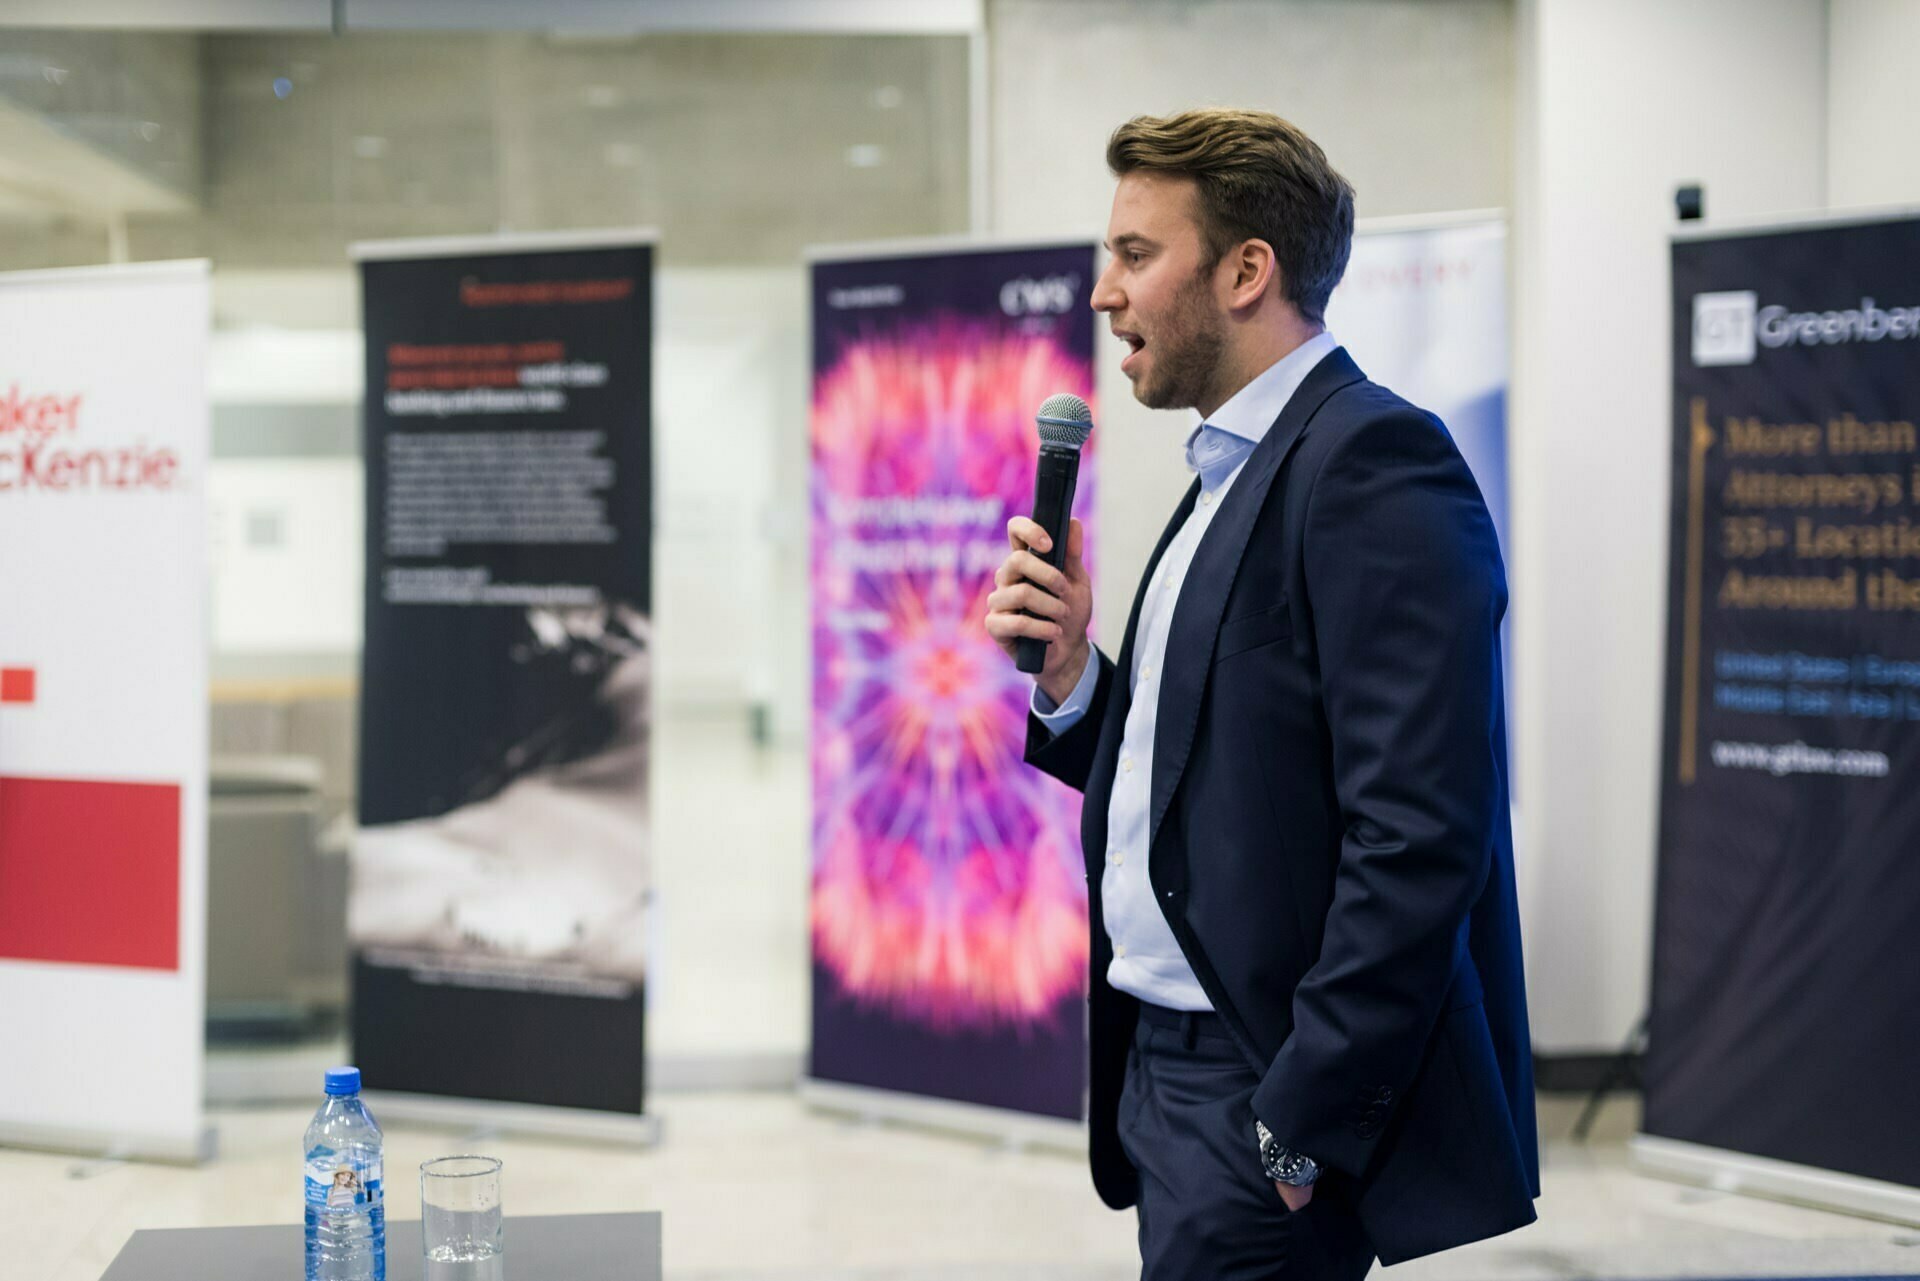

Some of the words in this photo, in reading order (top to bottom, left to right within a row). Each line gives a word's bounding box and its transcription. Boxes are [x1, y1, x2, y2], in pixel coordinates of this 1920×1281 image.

[1725, 417, 1821, 455] More
[1828, 413, 1916, 455] than
[1724, 470, 1903, 513] Attorneys
[1719, 567, 1856, 609] Around
